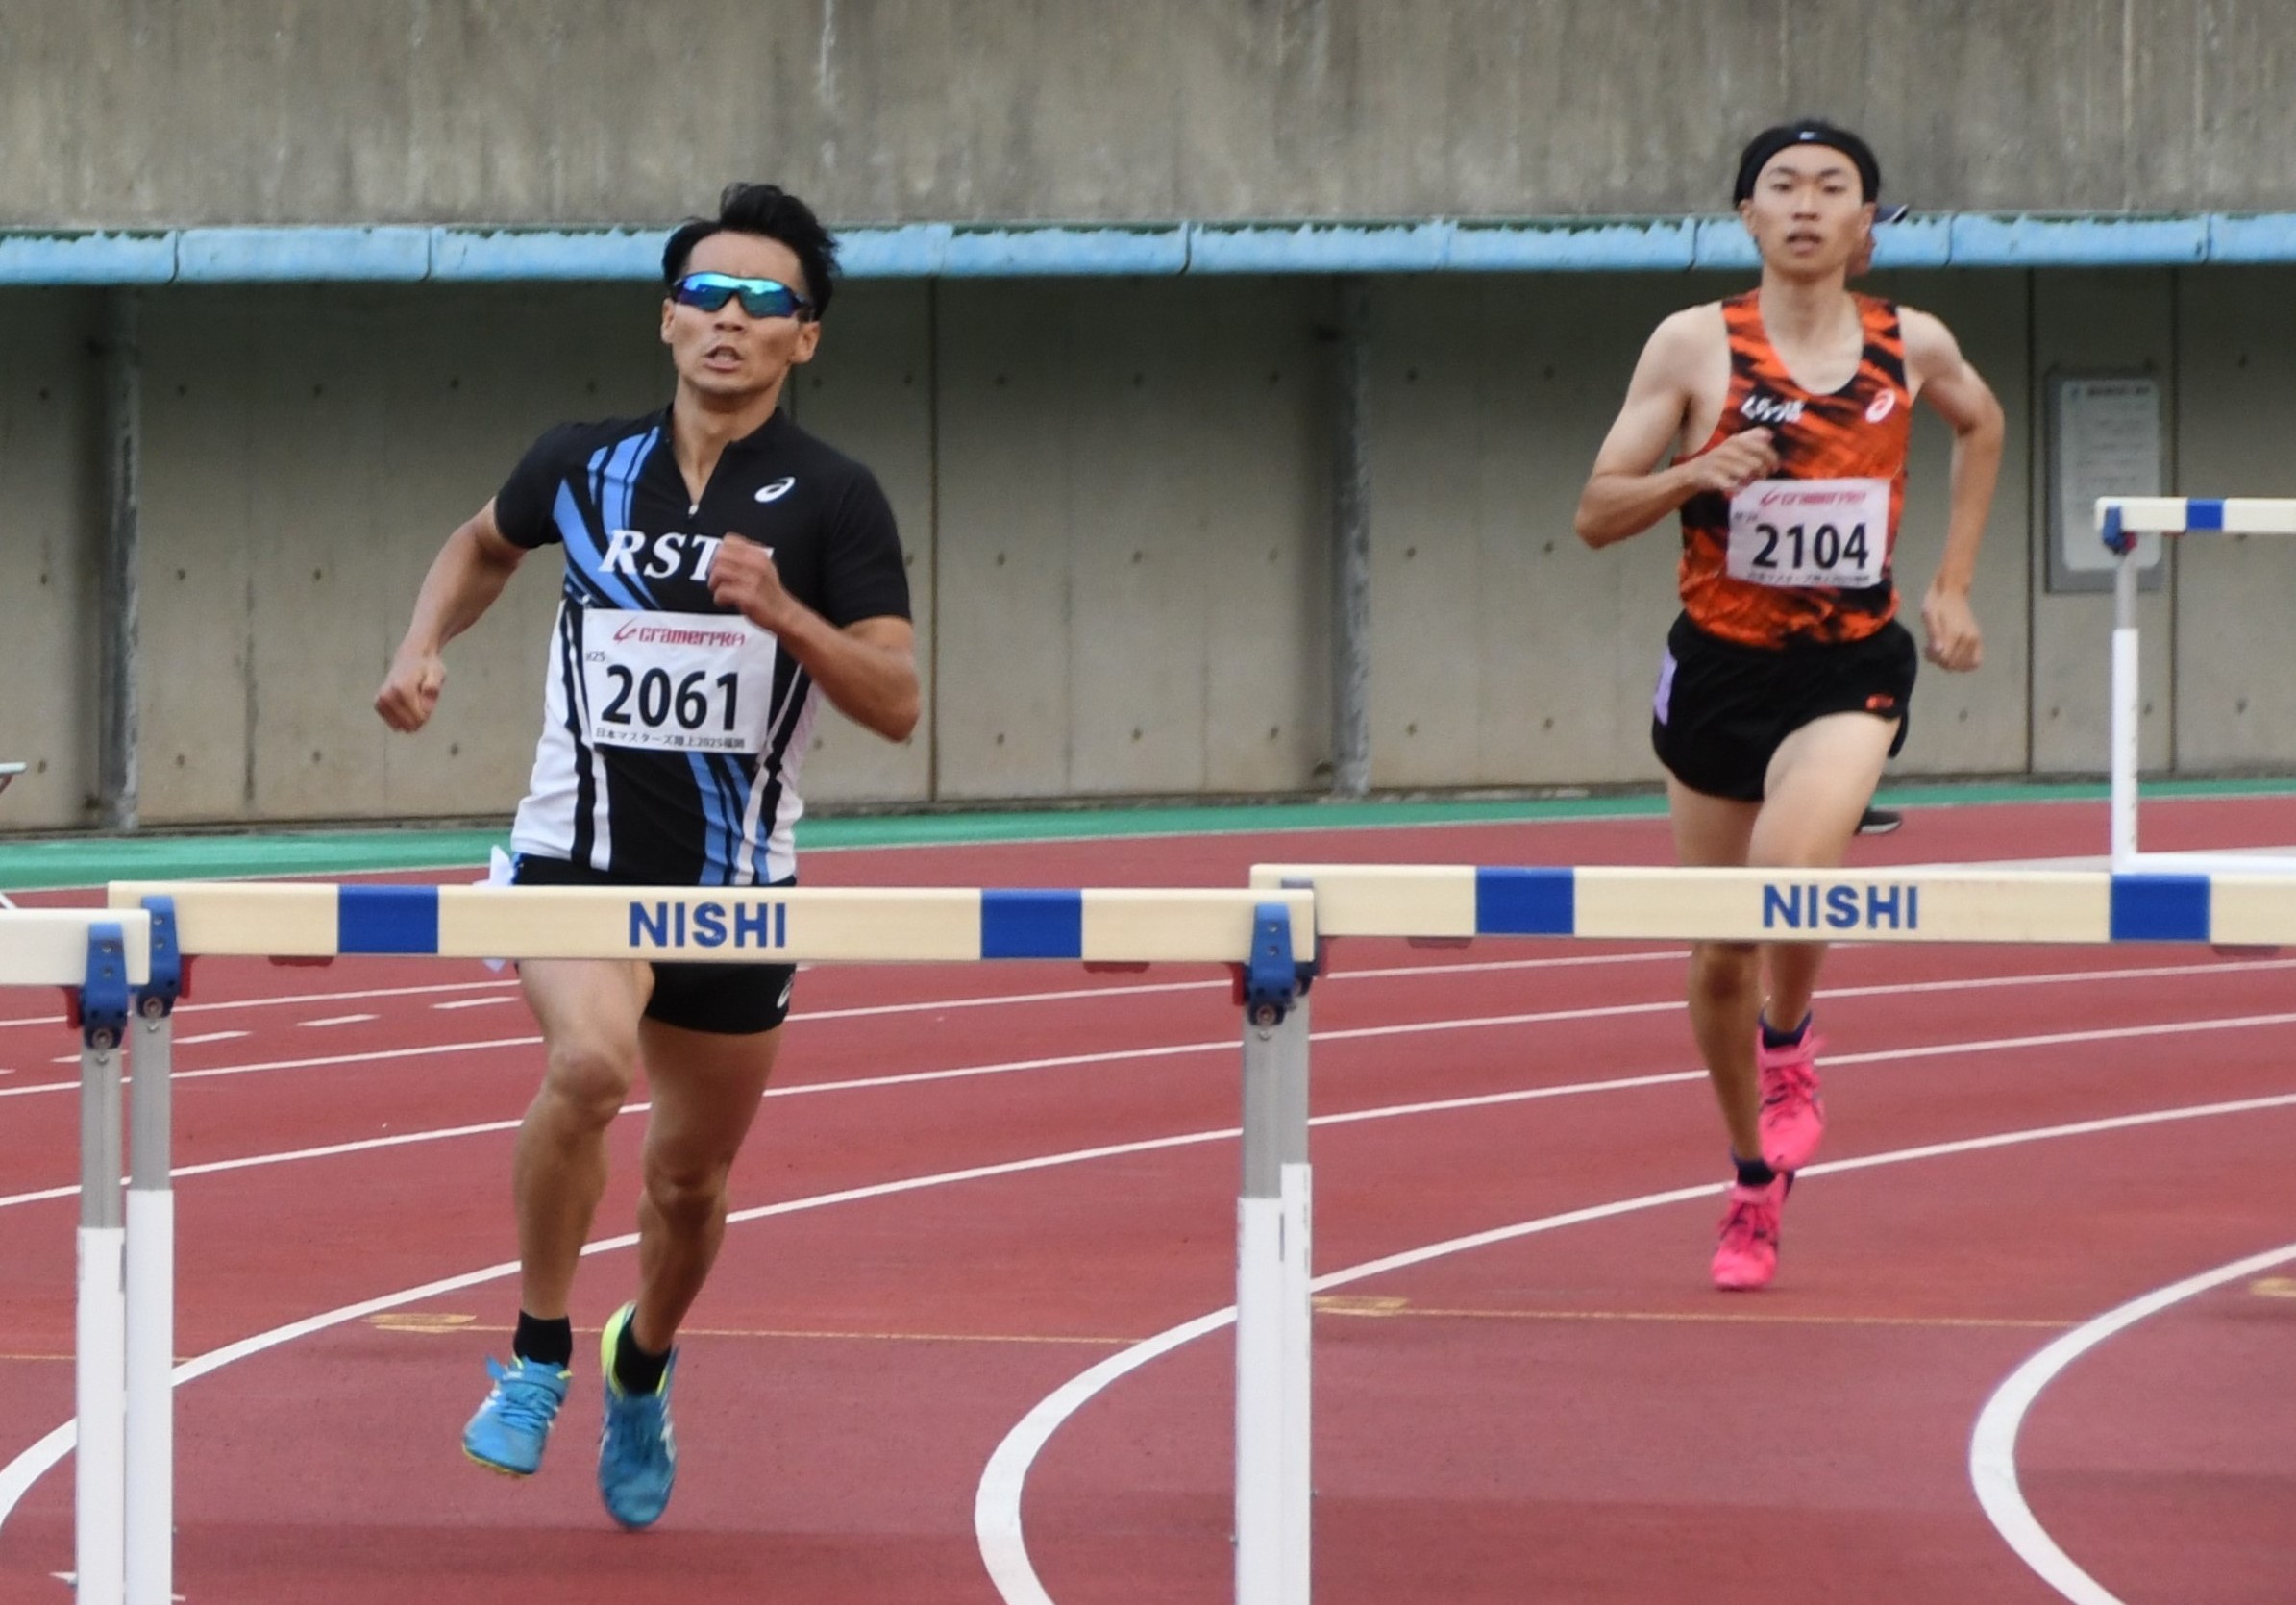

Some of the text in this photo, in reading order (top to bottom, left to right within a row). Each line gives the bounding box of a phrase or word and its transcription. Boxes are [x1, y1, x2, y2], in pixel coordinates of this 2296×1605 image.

[598, 529, 774, 581] RST
[1752, 522, 1868, 570] 2104
[602, 664, 739, 731] 2061
[629, 901, 786, 949] NISHI
[1762, 884, 1918, 930] NISHI
